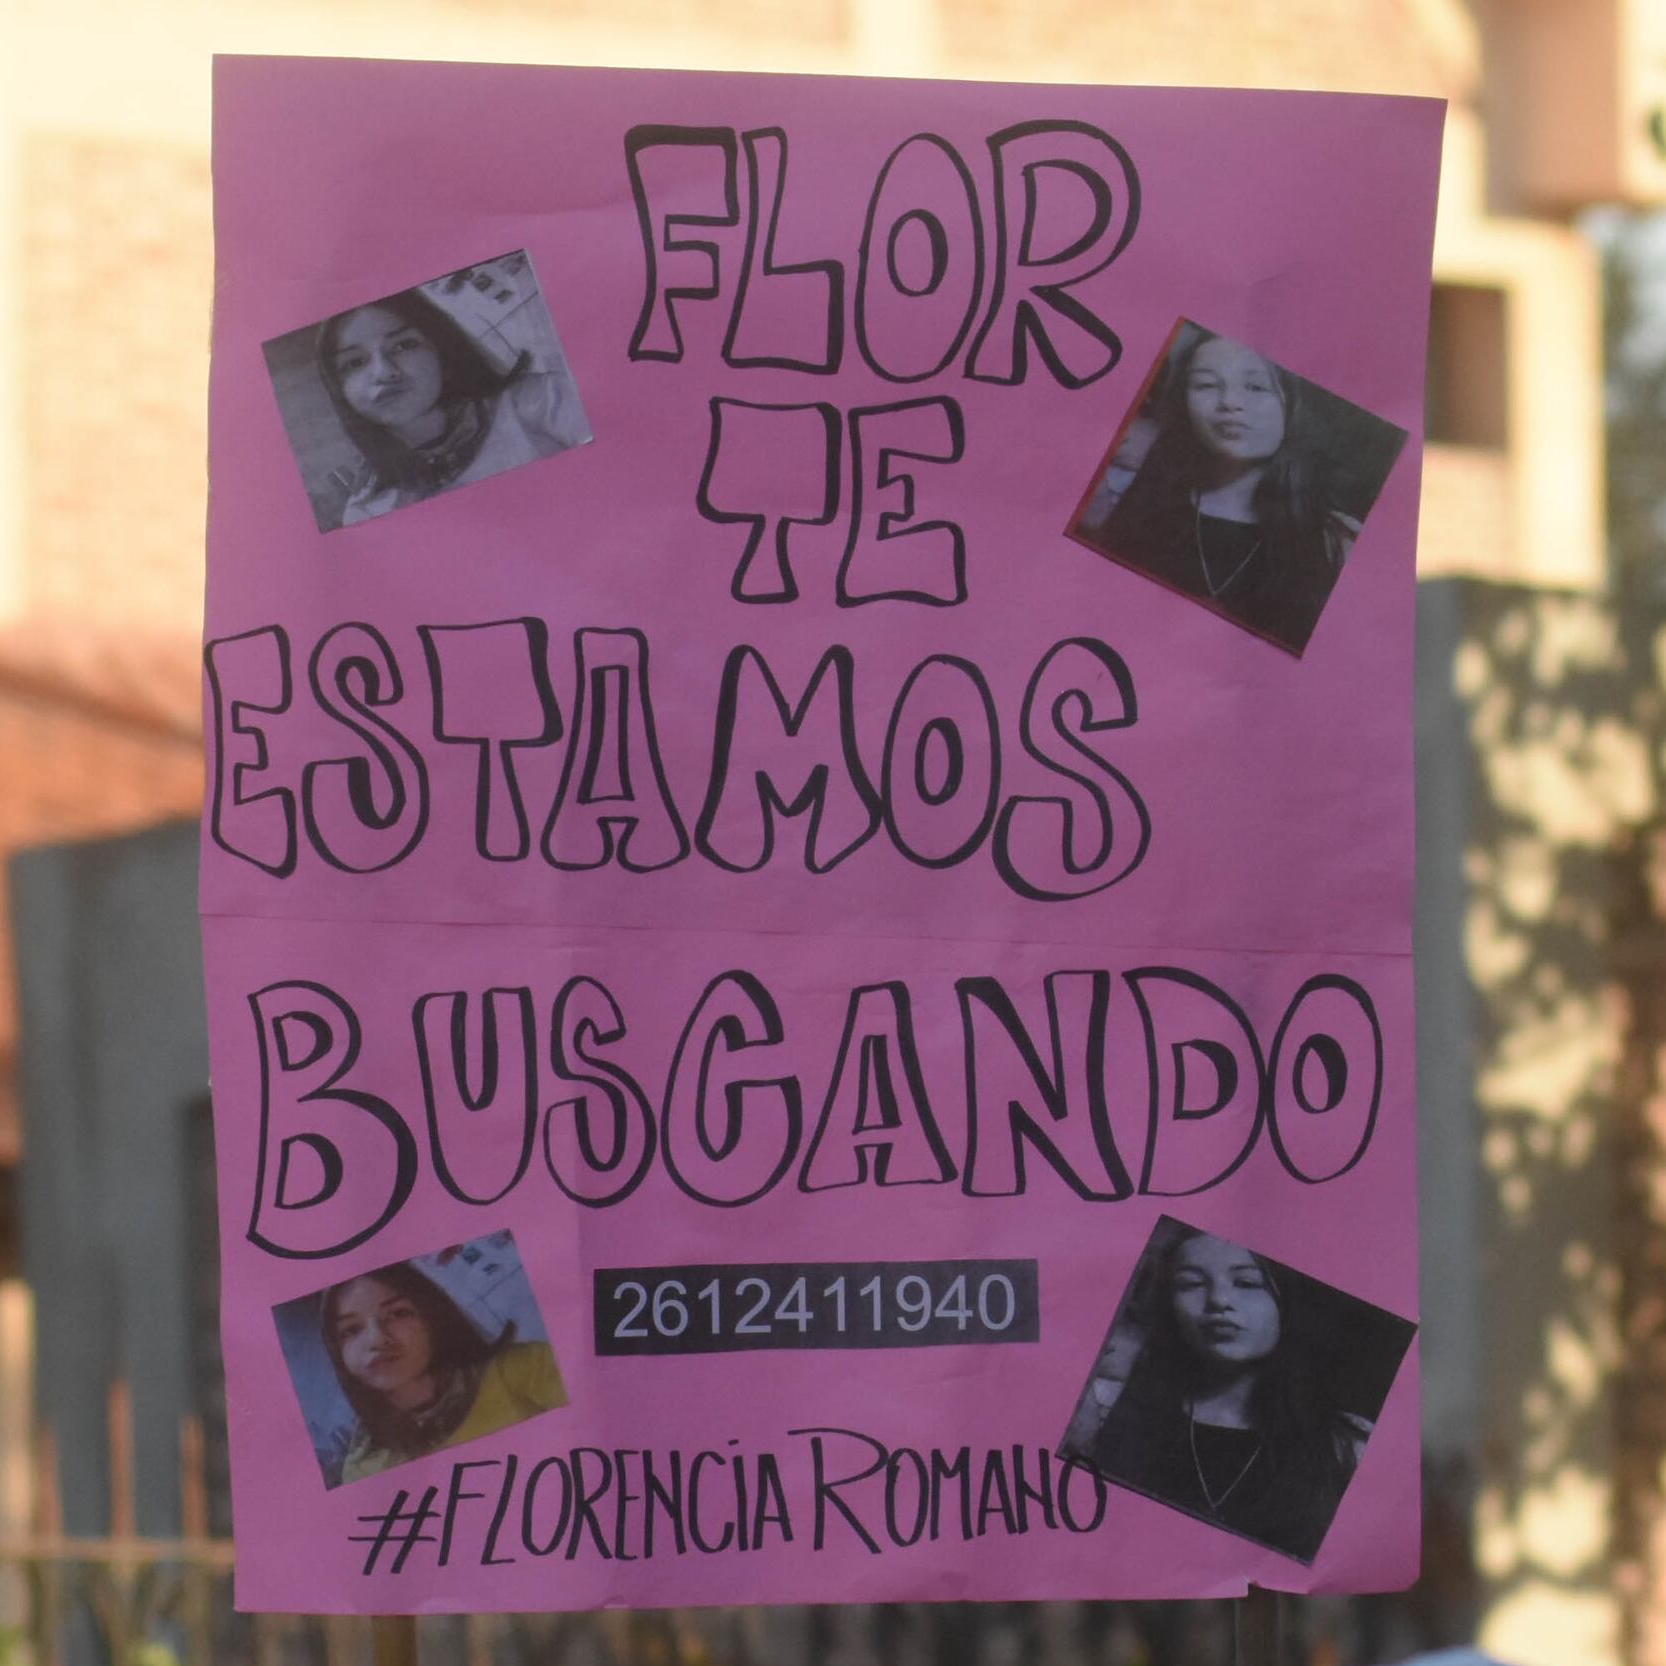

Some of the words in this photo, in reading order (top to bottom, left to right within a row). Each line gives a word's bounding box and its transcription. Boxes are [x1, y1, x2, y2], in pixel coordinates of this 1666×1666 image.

[625, 119, 1142, 391] FLOR
[695, 394, 970, 608] TE
[204, 616, 1153, 903] ESTAMOS
[245, 965, 1385, 1261] BUSCANDO
[613, 1273, 1016, 1338] 2612411940
[787, 1427, 1108, 1555] ROMANO
